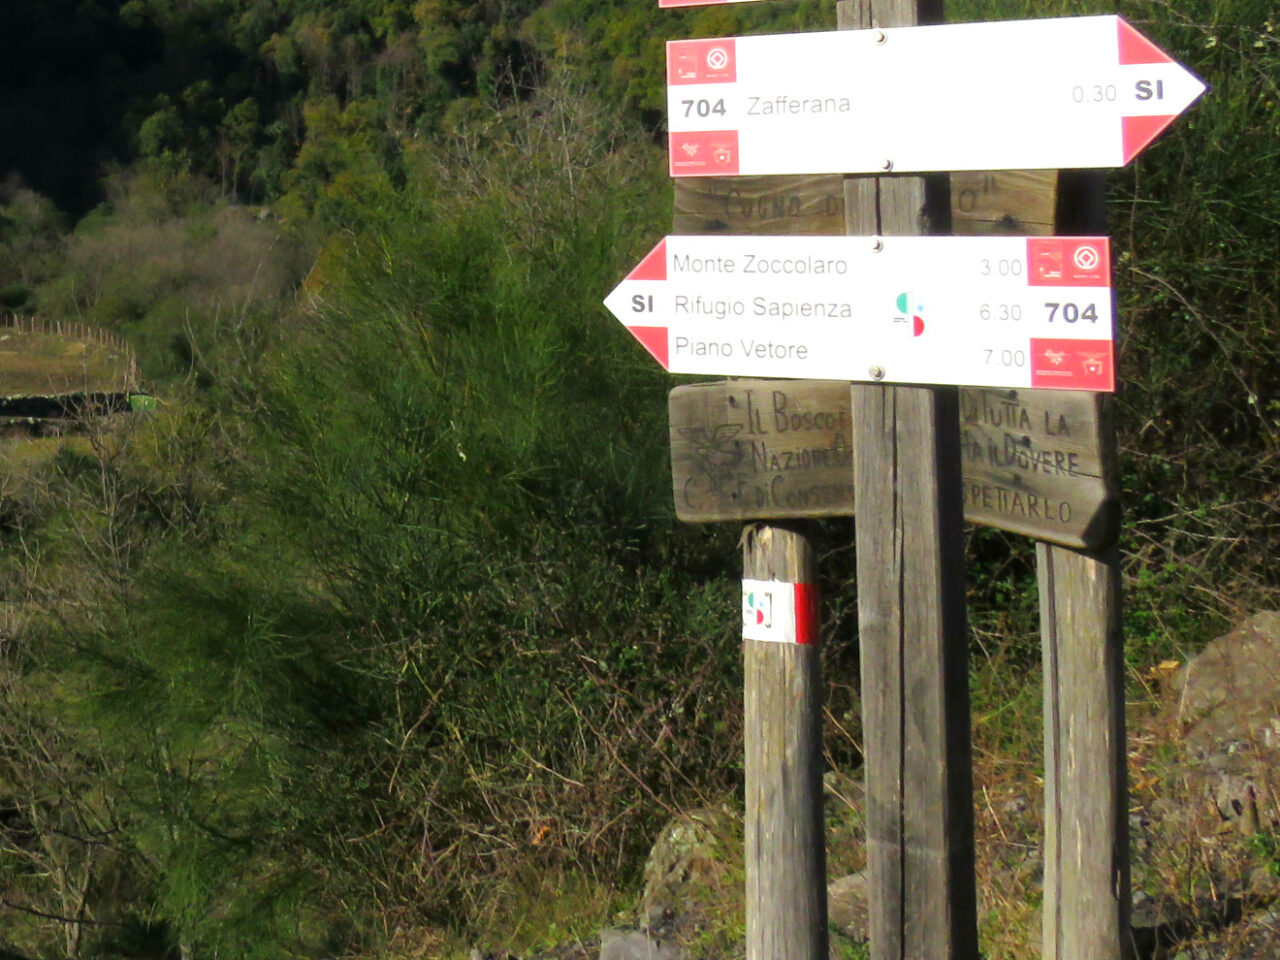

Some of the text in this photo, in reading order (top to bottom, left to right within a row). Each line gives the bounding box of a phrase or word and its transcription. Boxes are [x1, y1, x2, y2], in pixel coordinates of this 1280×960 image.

[746, 83, 1117, 116] Zafferana 0.30
[1133, 78, 1165, 102] SI
[680, 97, 728, 119] 704
[673, 253, 736, 274] Monte
[742, 254, 848, 276] Zoccolaro
[630, 293, 654, 314] SI
[674, 294, 1022, 322] Rifugio Sapienza 6.30
[1043, 301, 1100, 325] 704
[675, 335, 734, 358] Piano
[739, 338, 809, 361] Vetore
